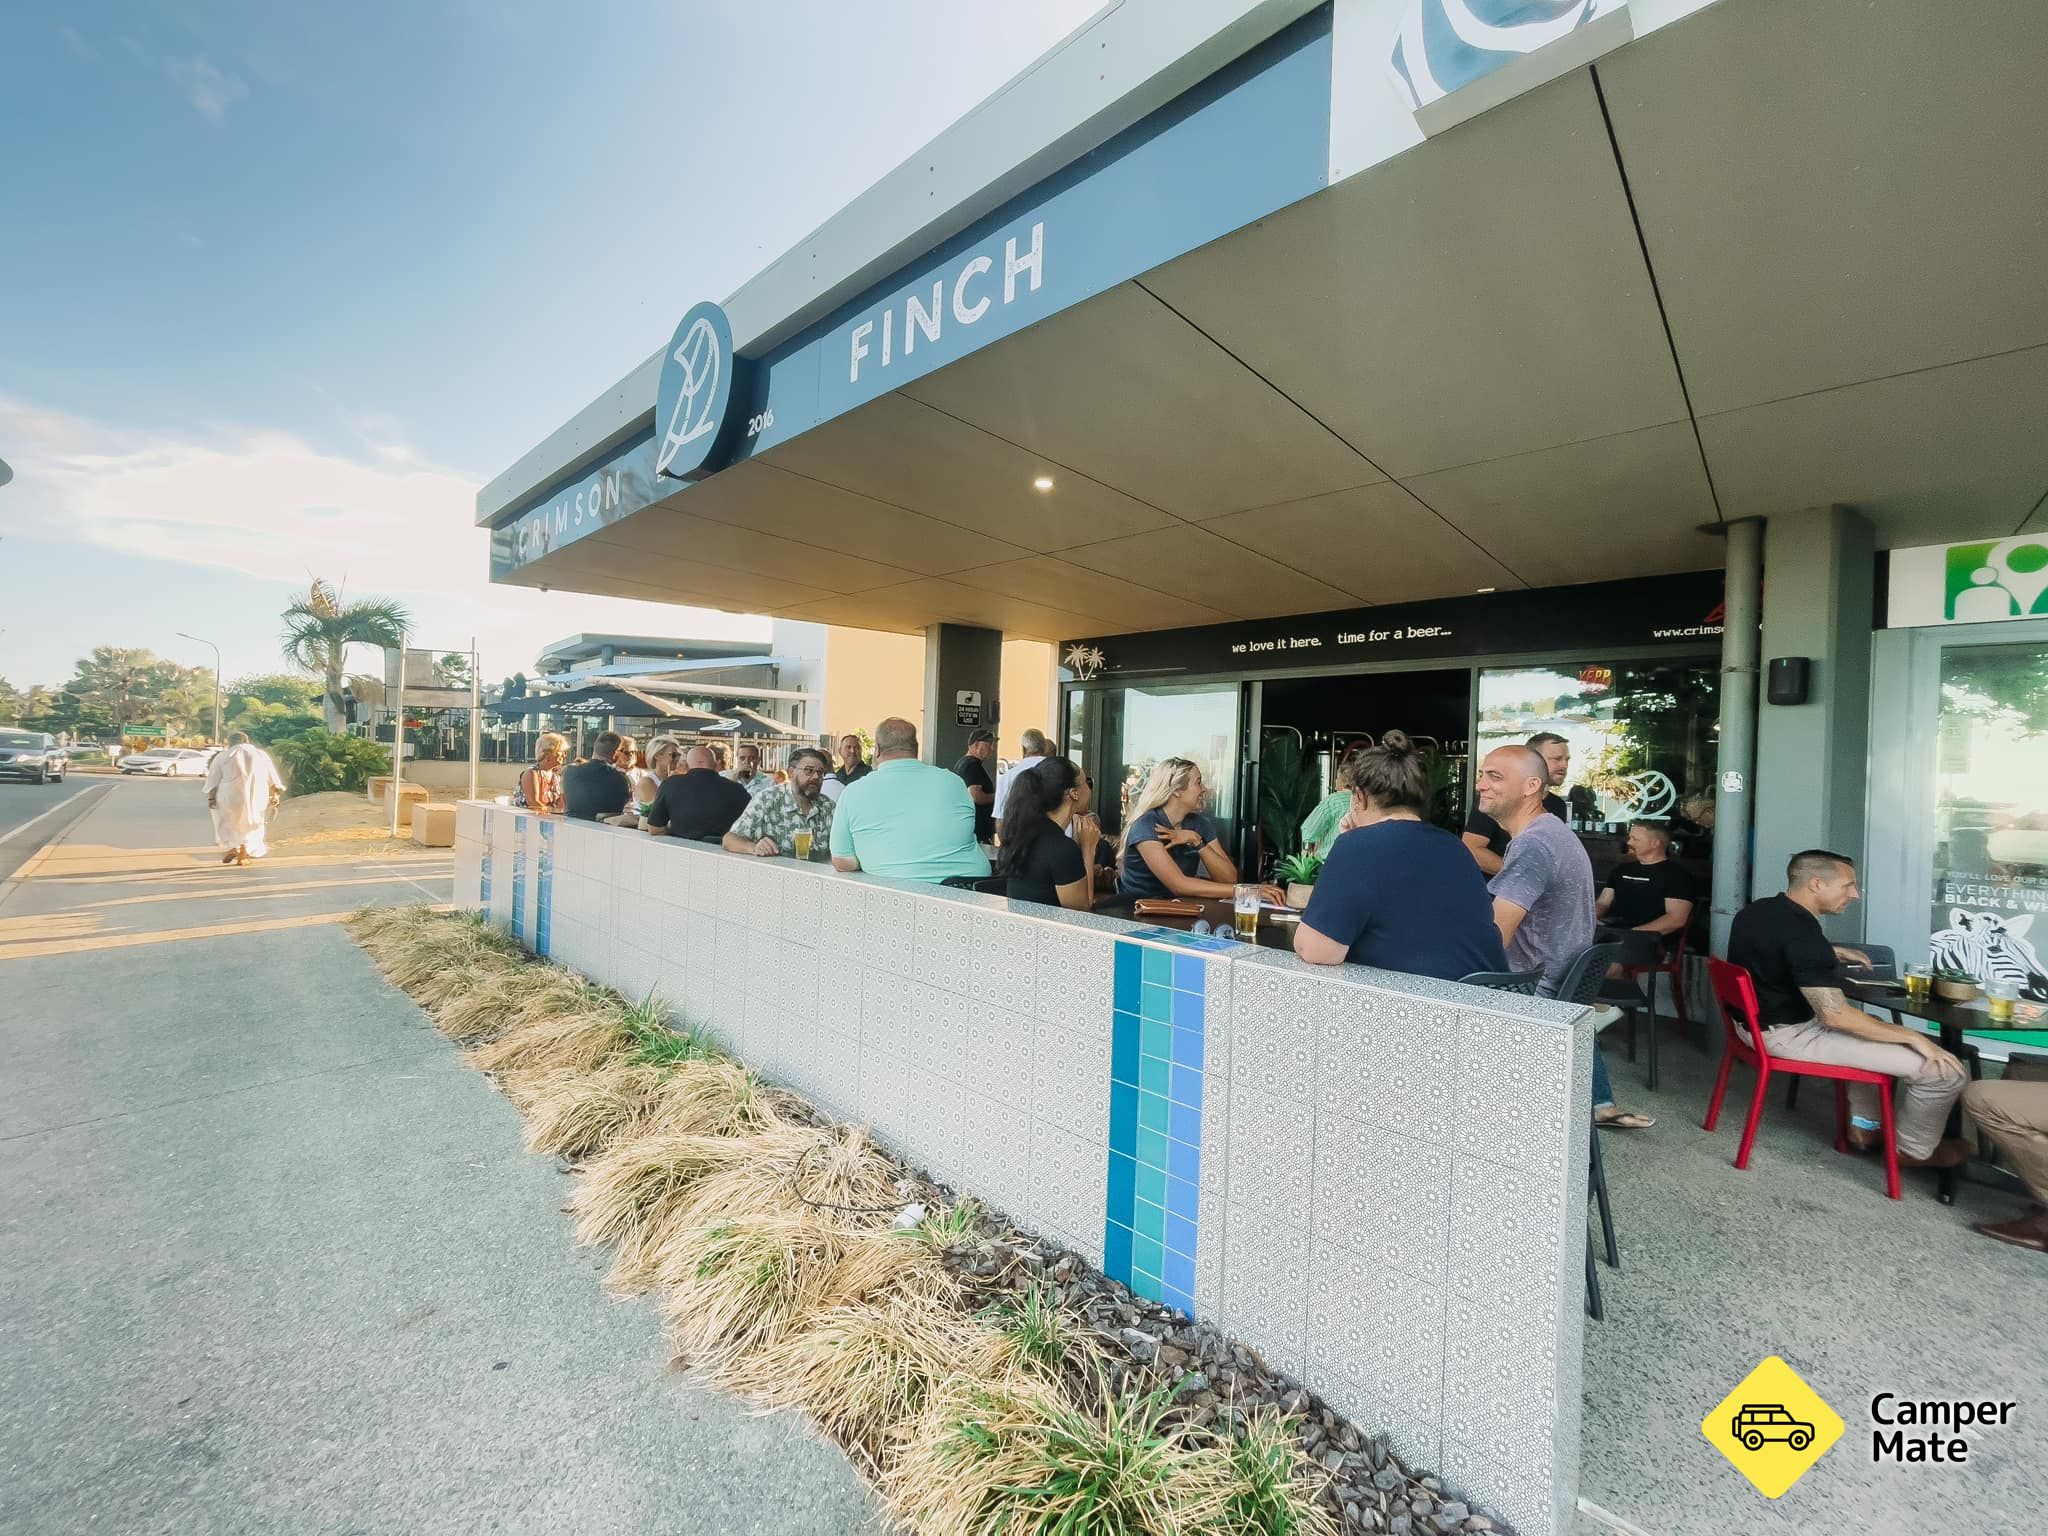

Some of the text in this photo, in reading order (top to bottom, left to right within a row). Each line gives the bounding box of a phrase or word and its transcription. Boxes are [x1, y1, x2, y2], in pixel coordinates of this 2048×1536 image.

[850, 222, 1044, 384] FINCH
[747, 408, 774, 437] 2016
[518, 470, 621, 556] CRIMSON
[1232, 637, 1322, 653] we love it here.
[1337, 626, 1452, 644] time for a beer...
[1944, 894, 2001, 908] BLACK
[2006, 899, 2018, 910] &
